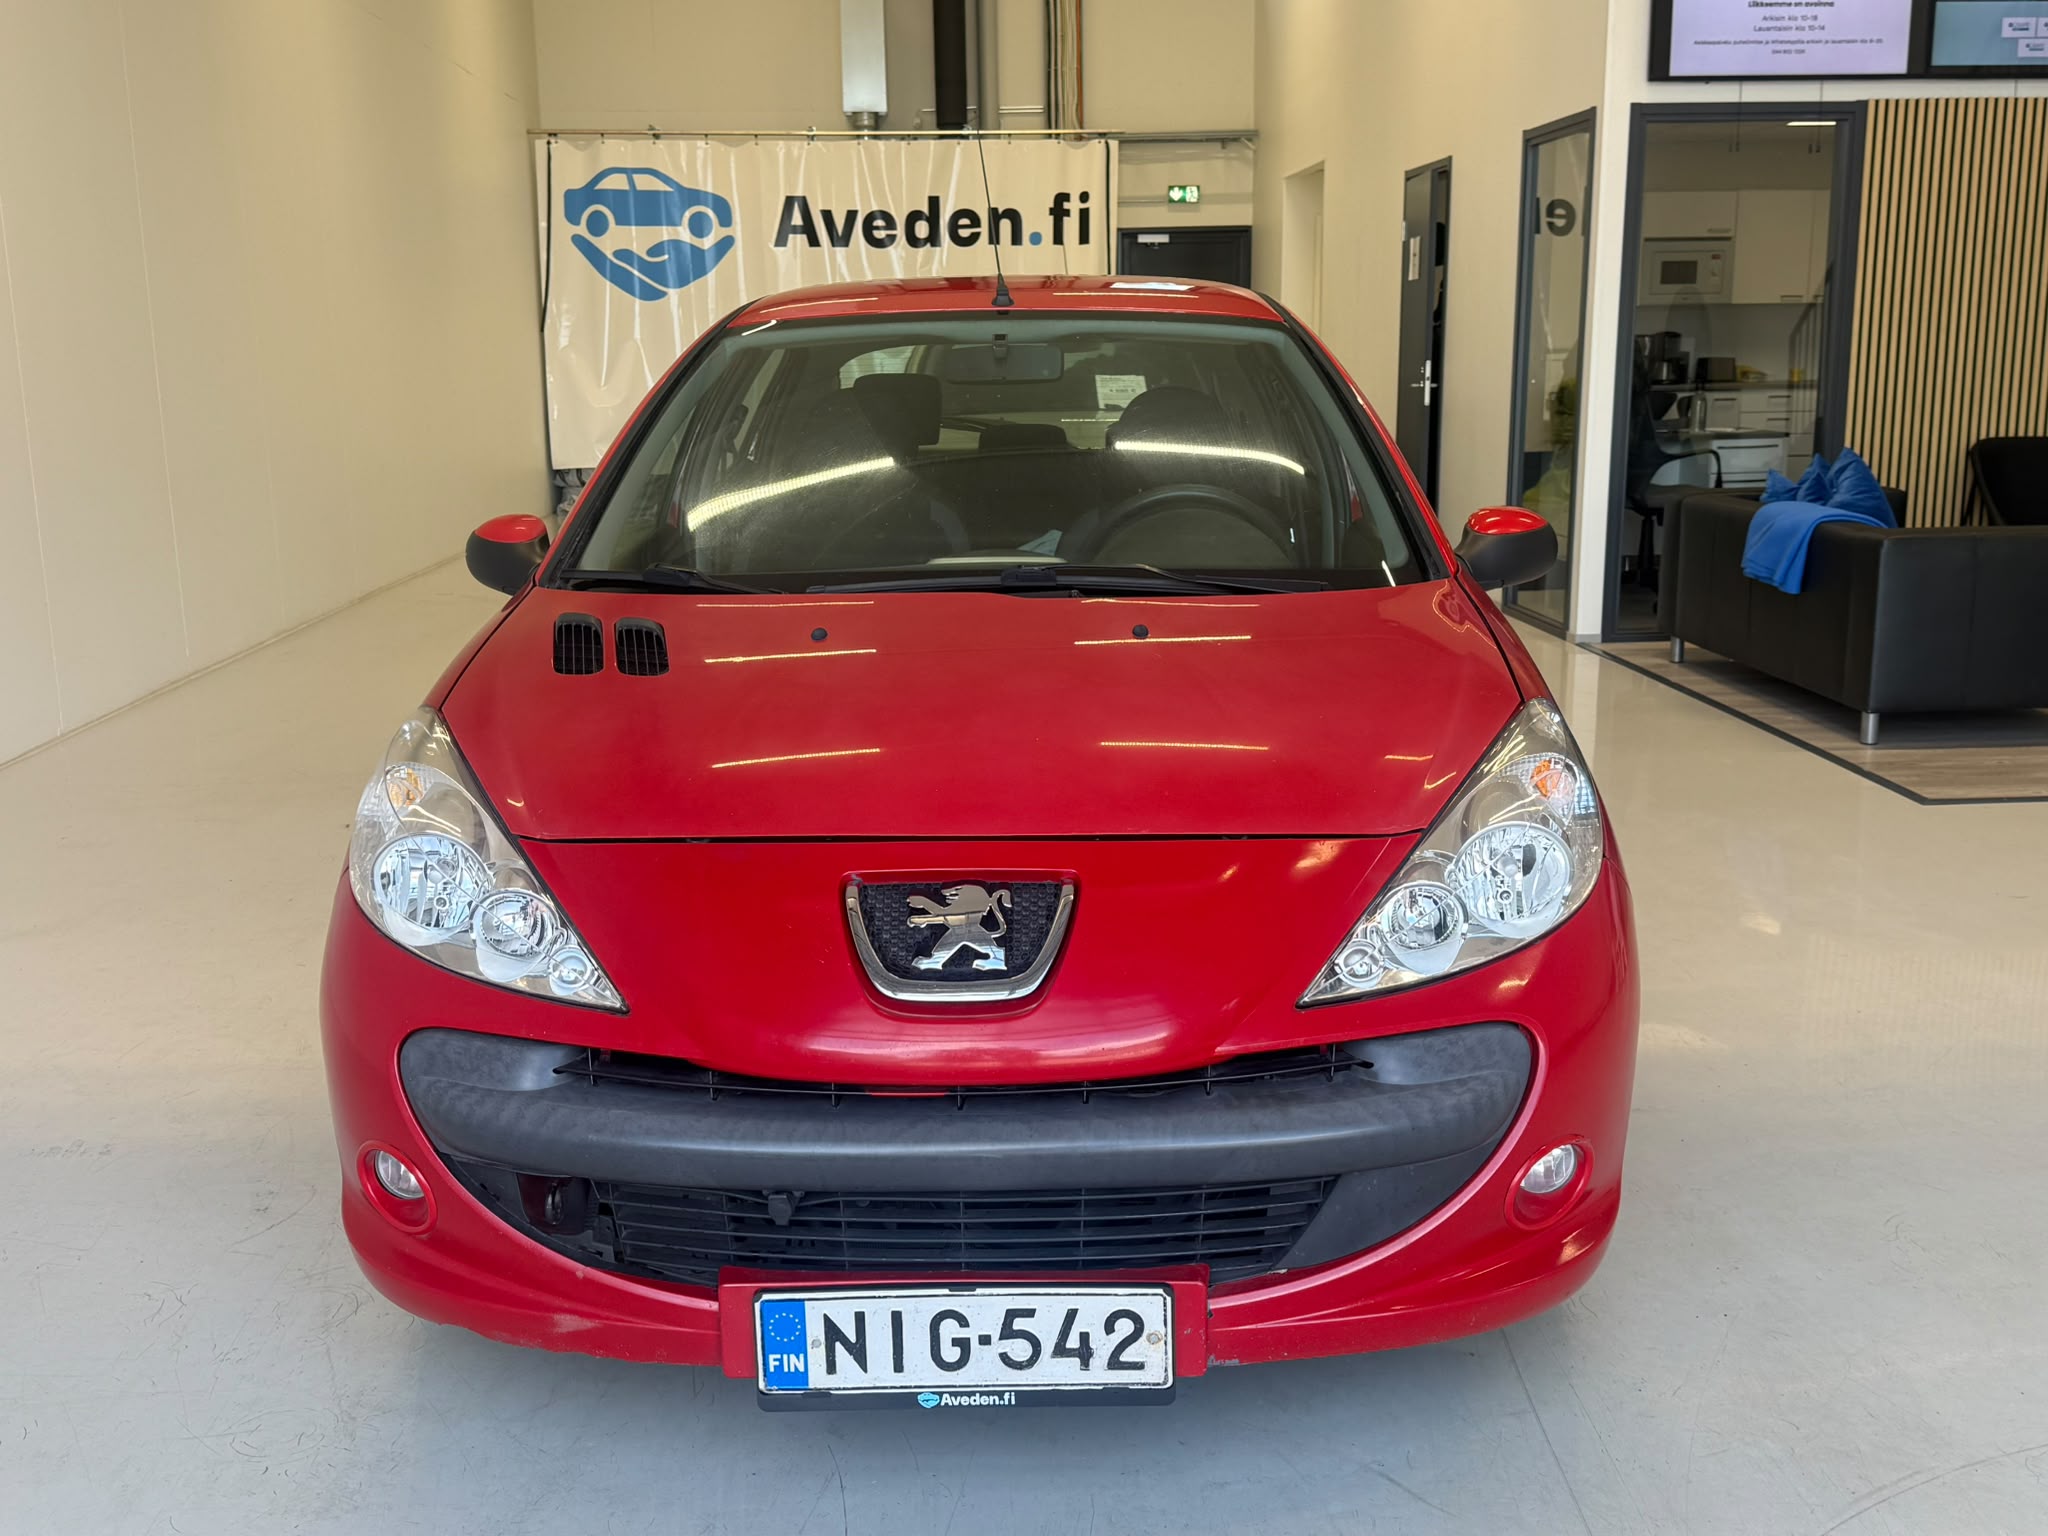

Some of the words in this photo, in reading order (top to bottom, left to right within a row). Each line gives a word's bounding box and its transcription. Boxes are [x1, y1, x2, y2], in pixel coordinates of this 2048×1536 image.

[774, 191, 1090, 248] Aveden.fi
[823, 1308, 1146, 1376] NIG-542
[768, 1353, 805, 1373] FIN
[940, 1391, 1016, 1407] Aveden.fi
